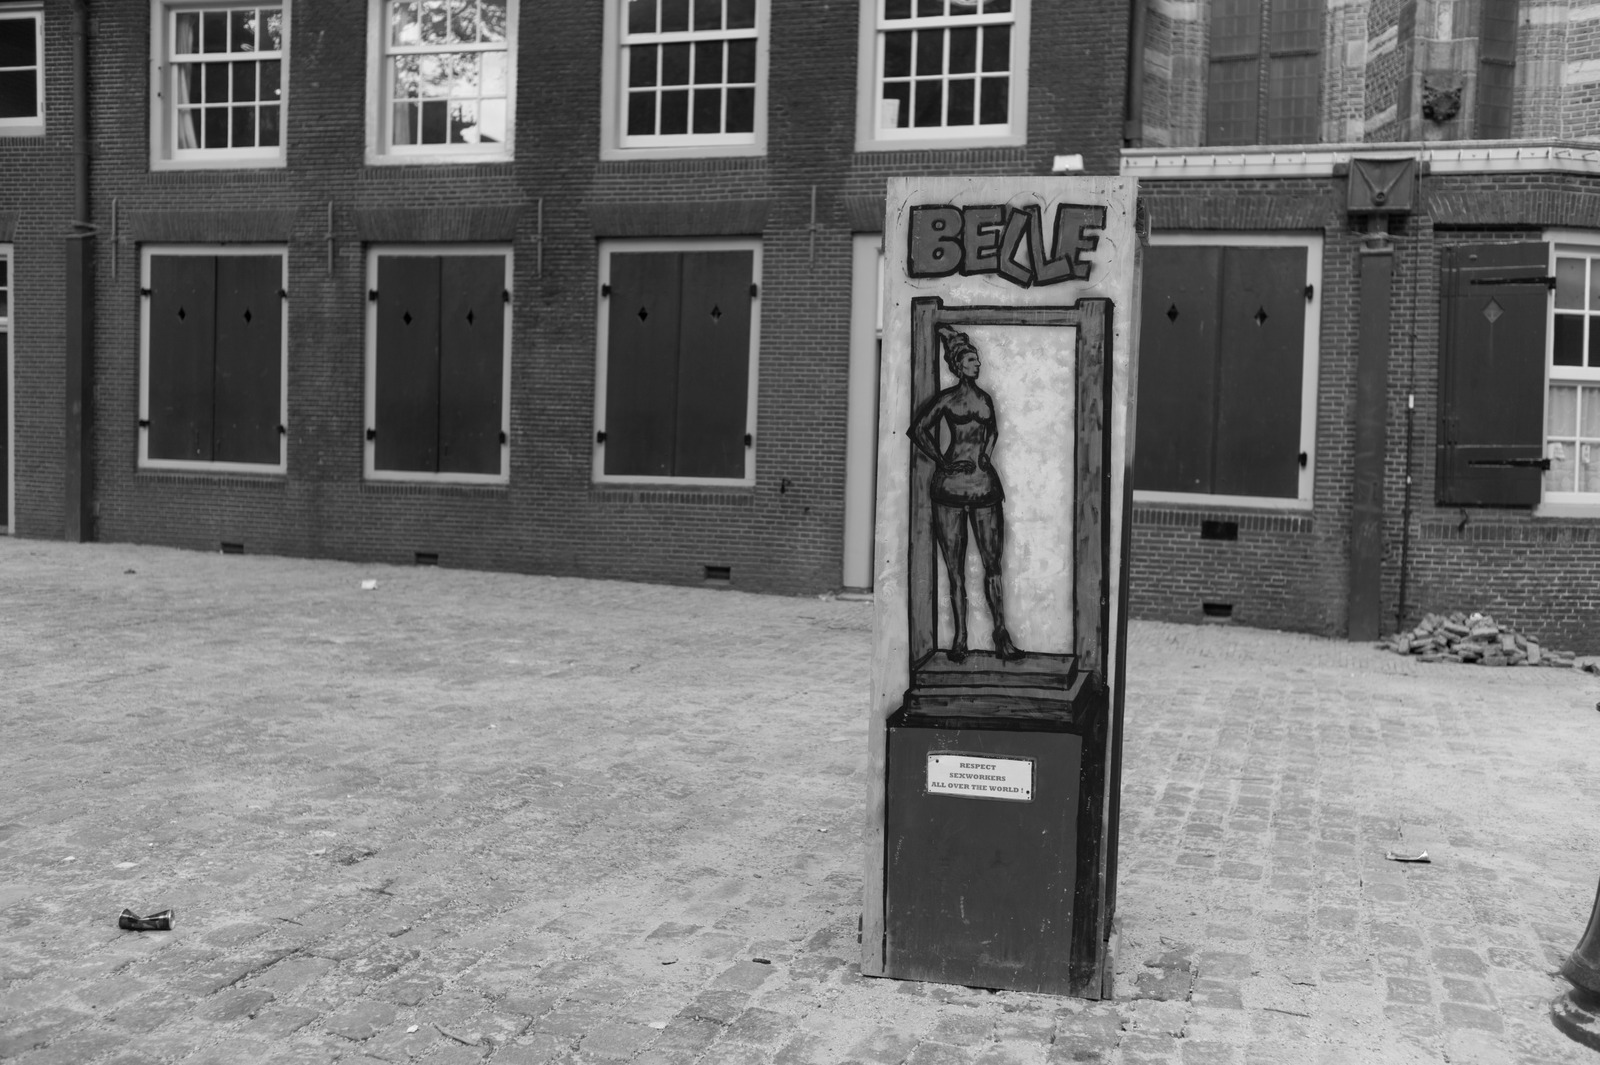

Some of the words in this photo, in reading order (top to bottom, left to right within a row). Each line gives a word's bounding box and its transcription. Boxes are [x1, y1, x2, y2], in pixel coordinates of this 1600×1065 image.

[907, 203, 1108, 289] BELLE
[949, 773, 1006, 781] SEXWORKERS
[989, 785, 1019, 793] WORLD
